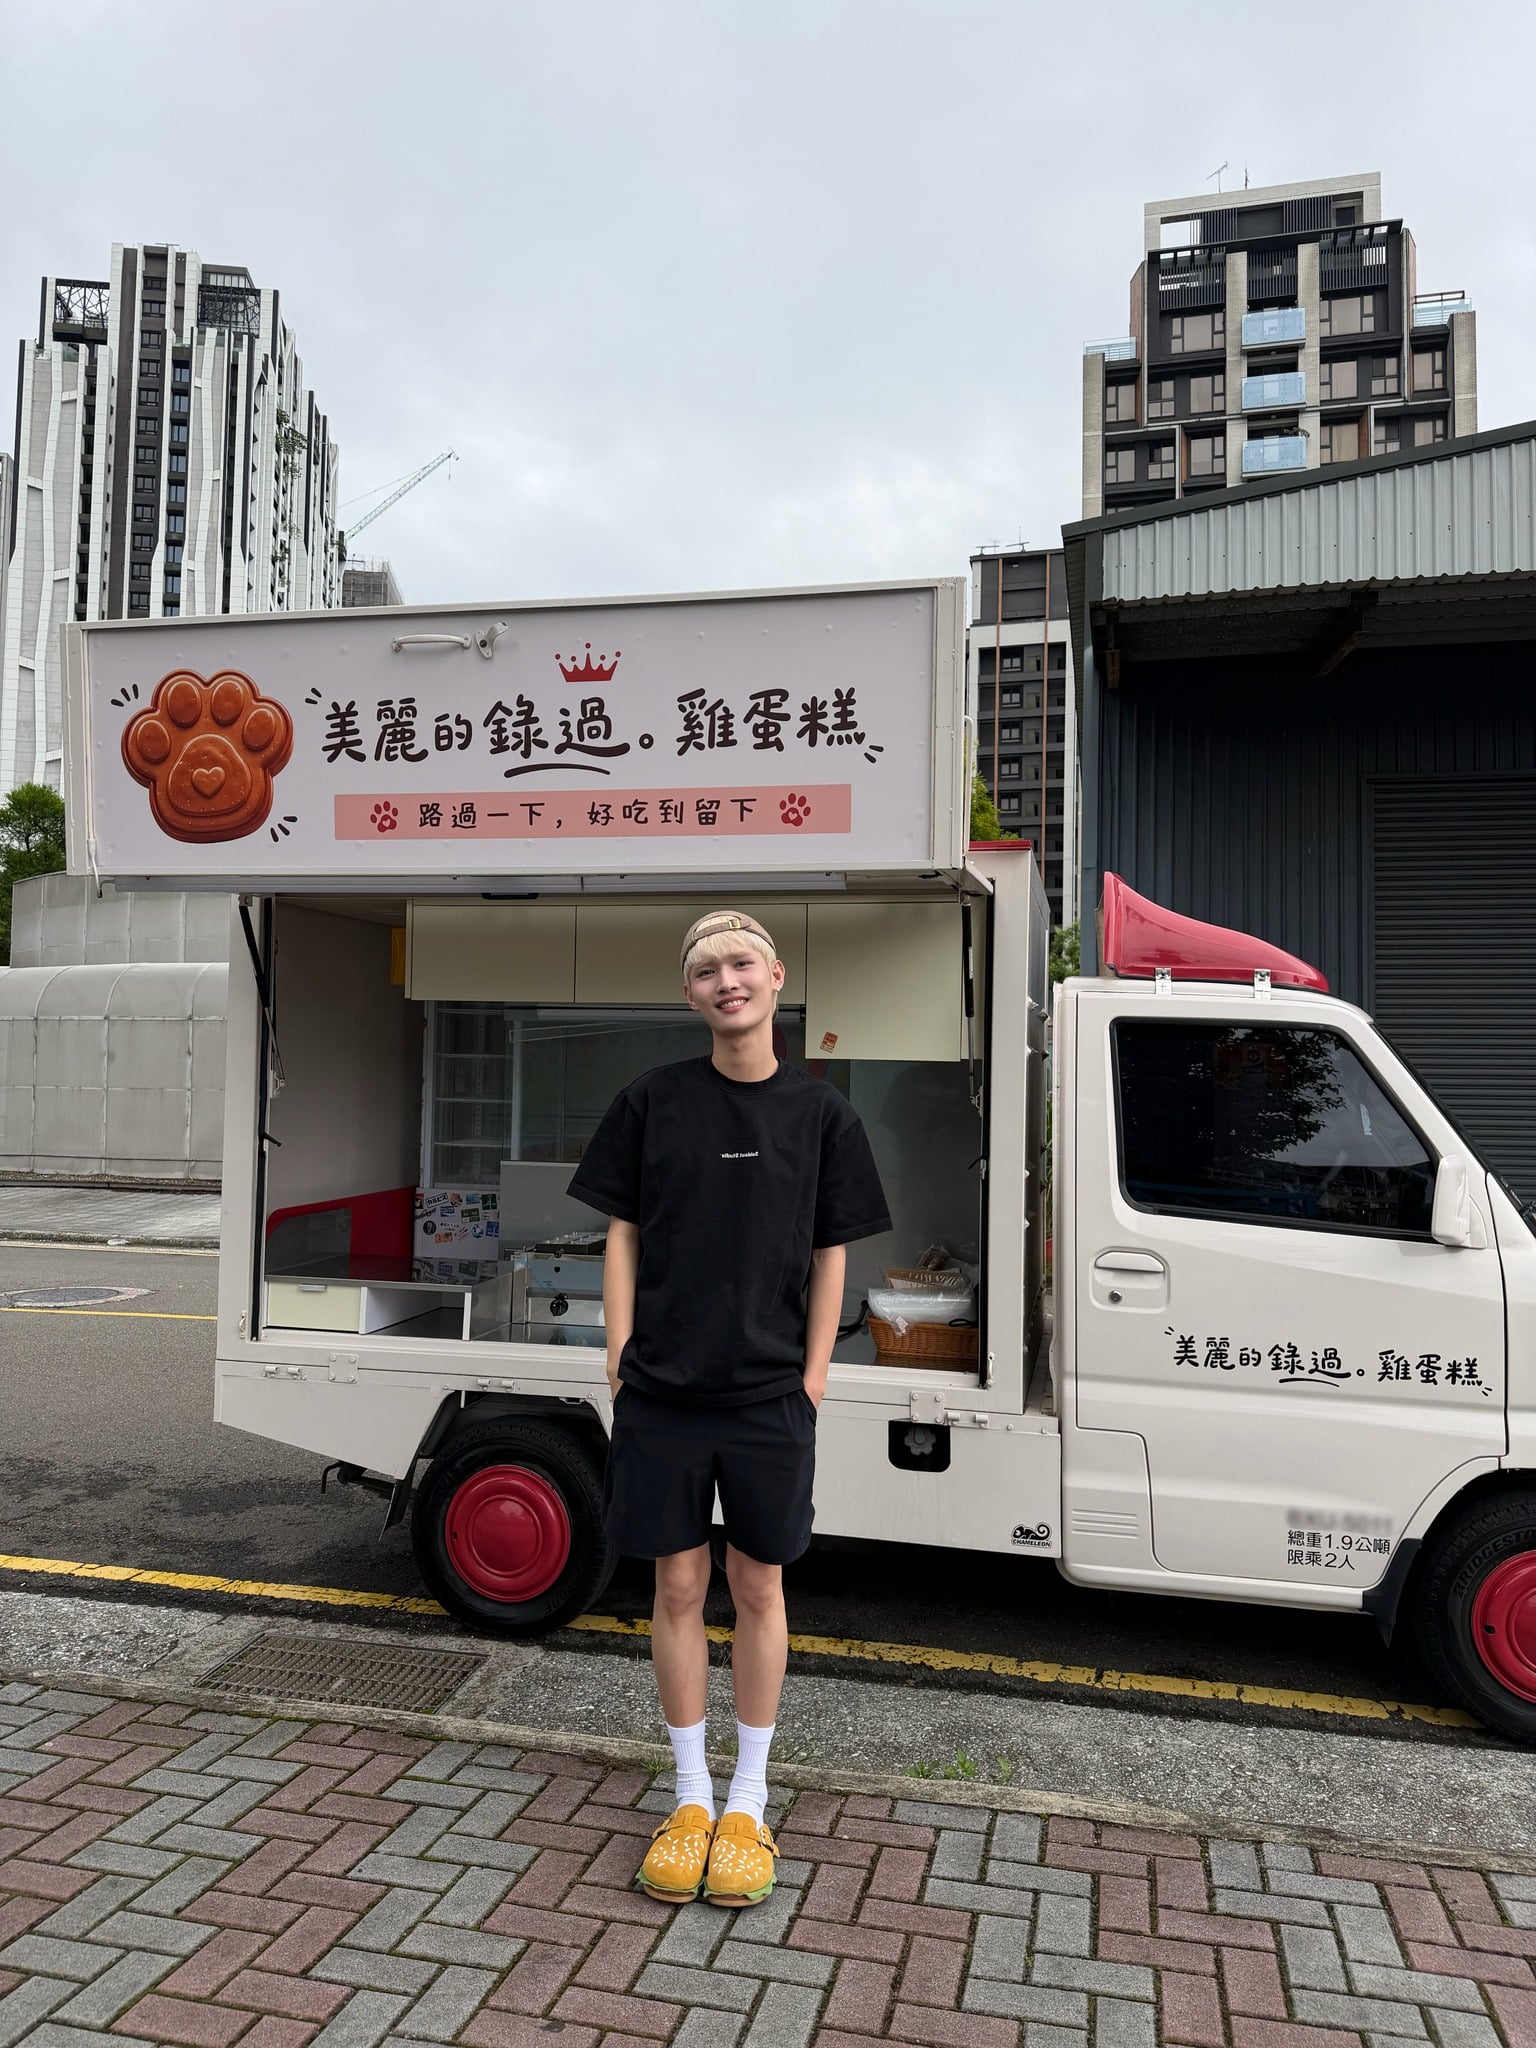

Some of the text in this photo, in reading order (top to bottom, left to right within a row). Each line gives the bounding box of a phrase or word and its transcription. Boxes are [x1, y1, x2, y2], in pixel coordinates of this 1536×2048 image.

[1012, 1539, 1051, 1547] CHAMELEON
[1287, 1529, 1391, 1555] 總重1.9公噸
[1287, 1549, 1355, 1571] 限乘2人
